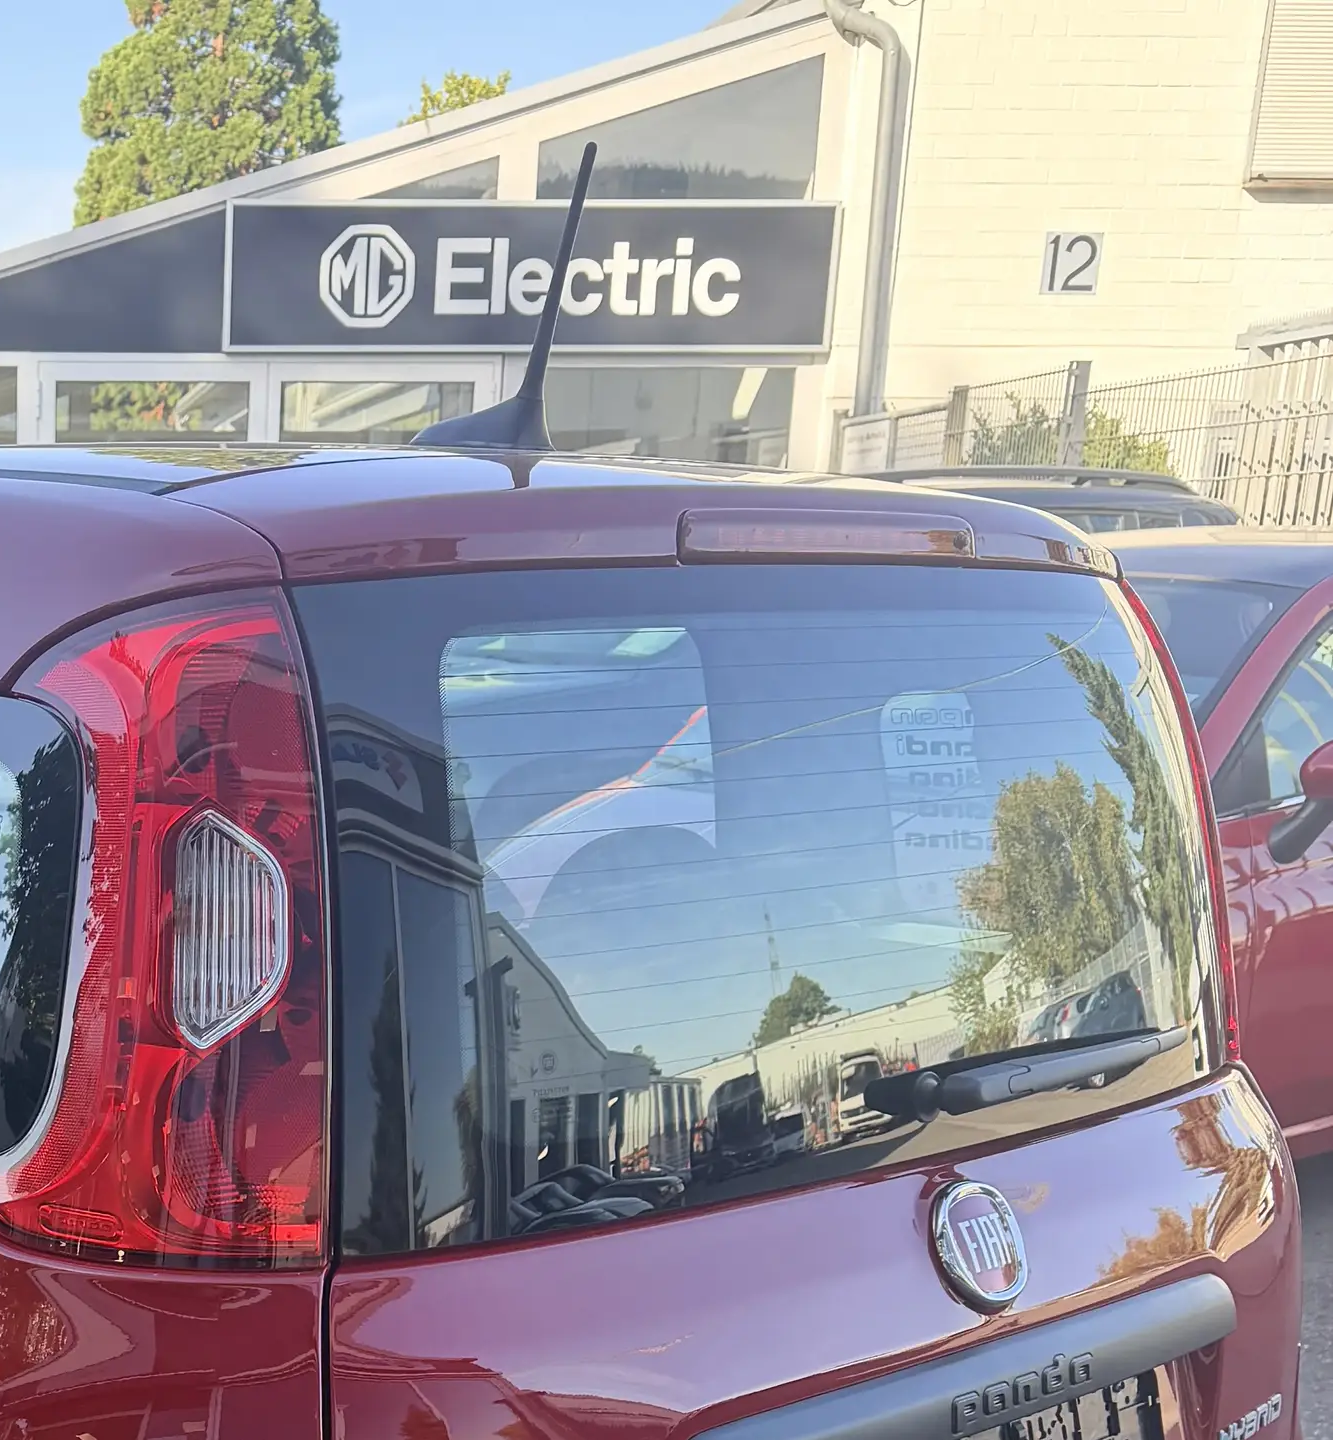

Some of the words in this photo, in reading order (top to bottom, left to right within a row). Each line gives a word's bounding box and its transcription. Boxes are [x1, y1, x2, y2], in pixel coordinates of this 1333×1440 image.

[329, 234, 406, 318] MG
[434, 236, 741, 317] Electric
[1048, 234, 1097, 291] 12
[957, 1212, 1012, 1274] FIAT
